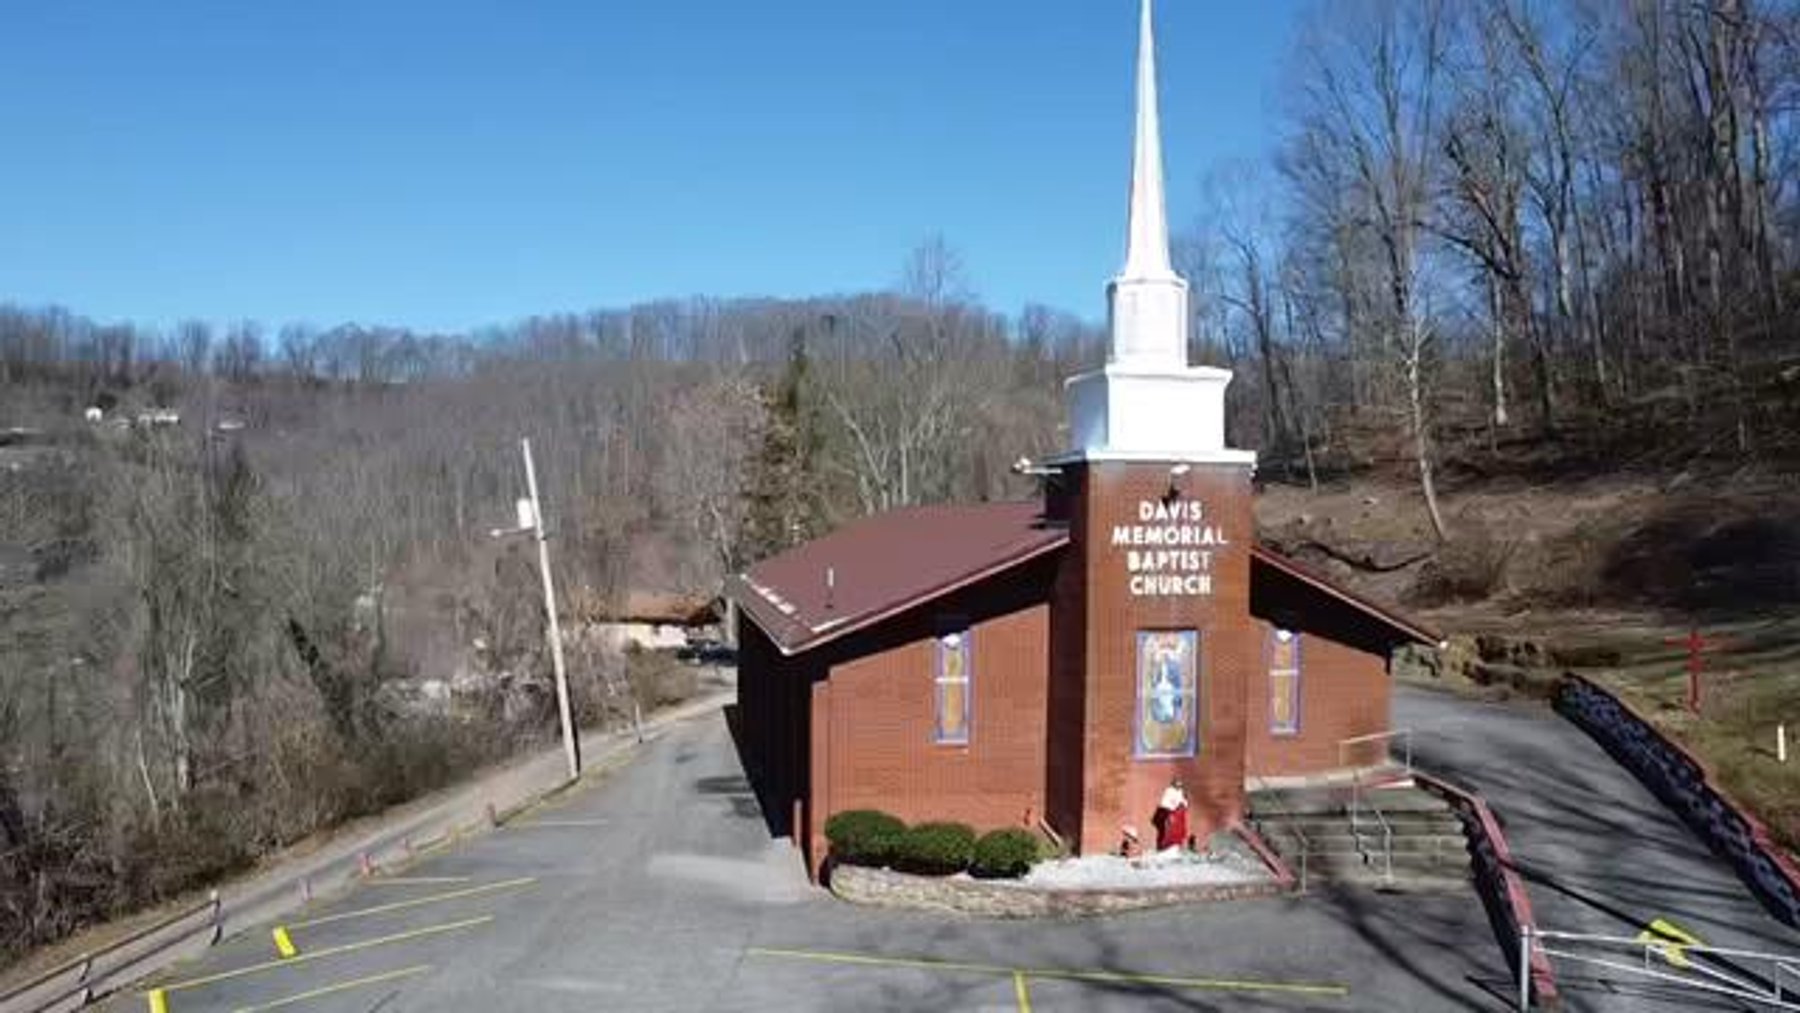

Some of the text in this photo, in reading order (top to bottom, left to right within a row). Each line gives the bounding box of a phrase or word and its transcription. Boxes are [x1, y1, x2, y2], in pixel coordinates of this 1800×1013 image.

[1139, 500, 1202, 521] DAVIS
[1112, 526, 1228, 545] MEMORIAL
[1127, 551, 1212, 571] BAPTIST
[1130, 575, 1211, 595] CHURCH
